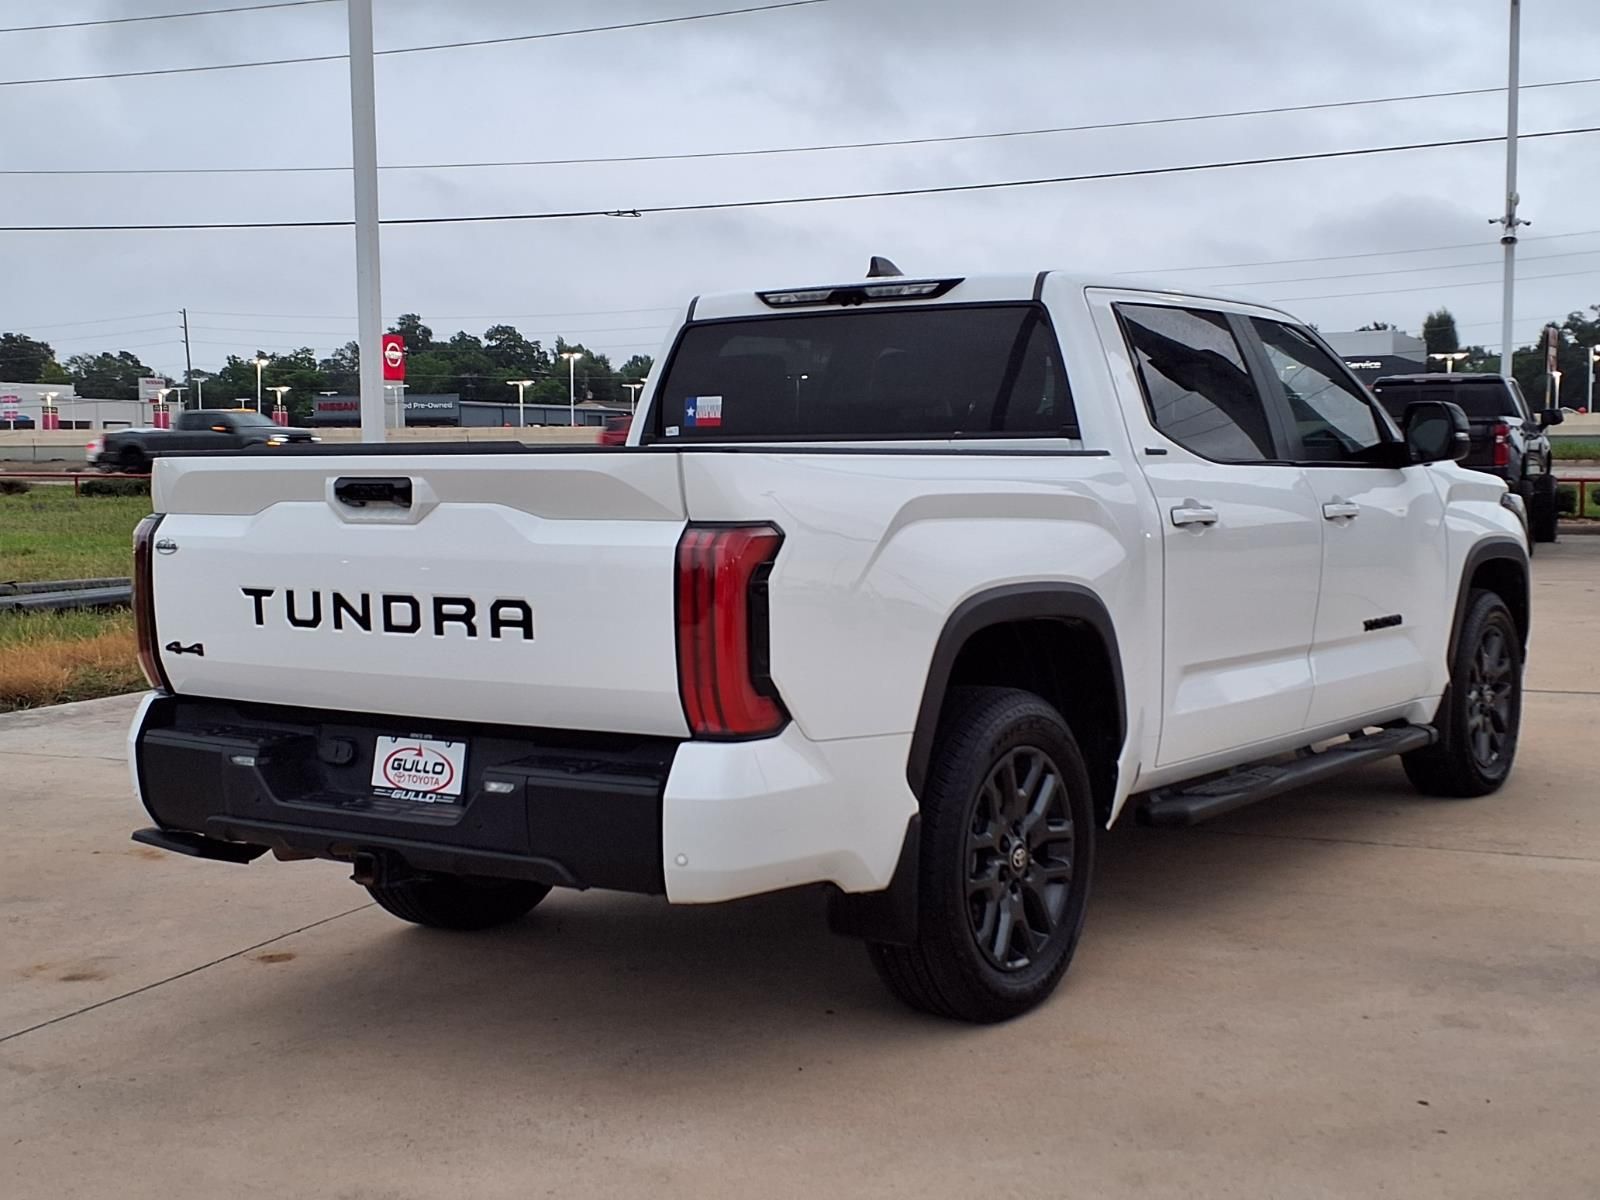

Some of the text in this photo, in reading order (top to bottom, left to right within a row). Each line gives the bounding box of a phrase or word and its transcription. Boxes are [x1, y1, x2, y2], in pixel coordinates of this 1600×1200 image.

[318, 402, 358, 411] NISSAN
[241, 587, 534, 640] TUNDRA
[391, 757, 445, 775] GULLO
[407, 774, 440, 786] TOYOTA
[391, 789, 437, 803] GULLO
